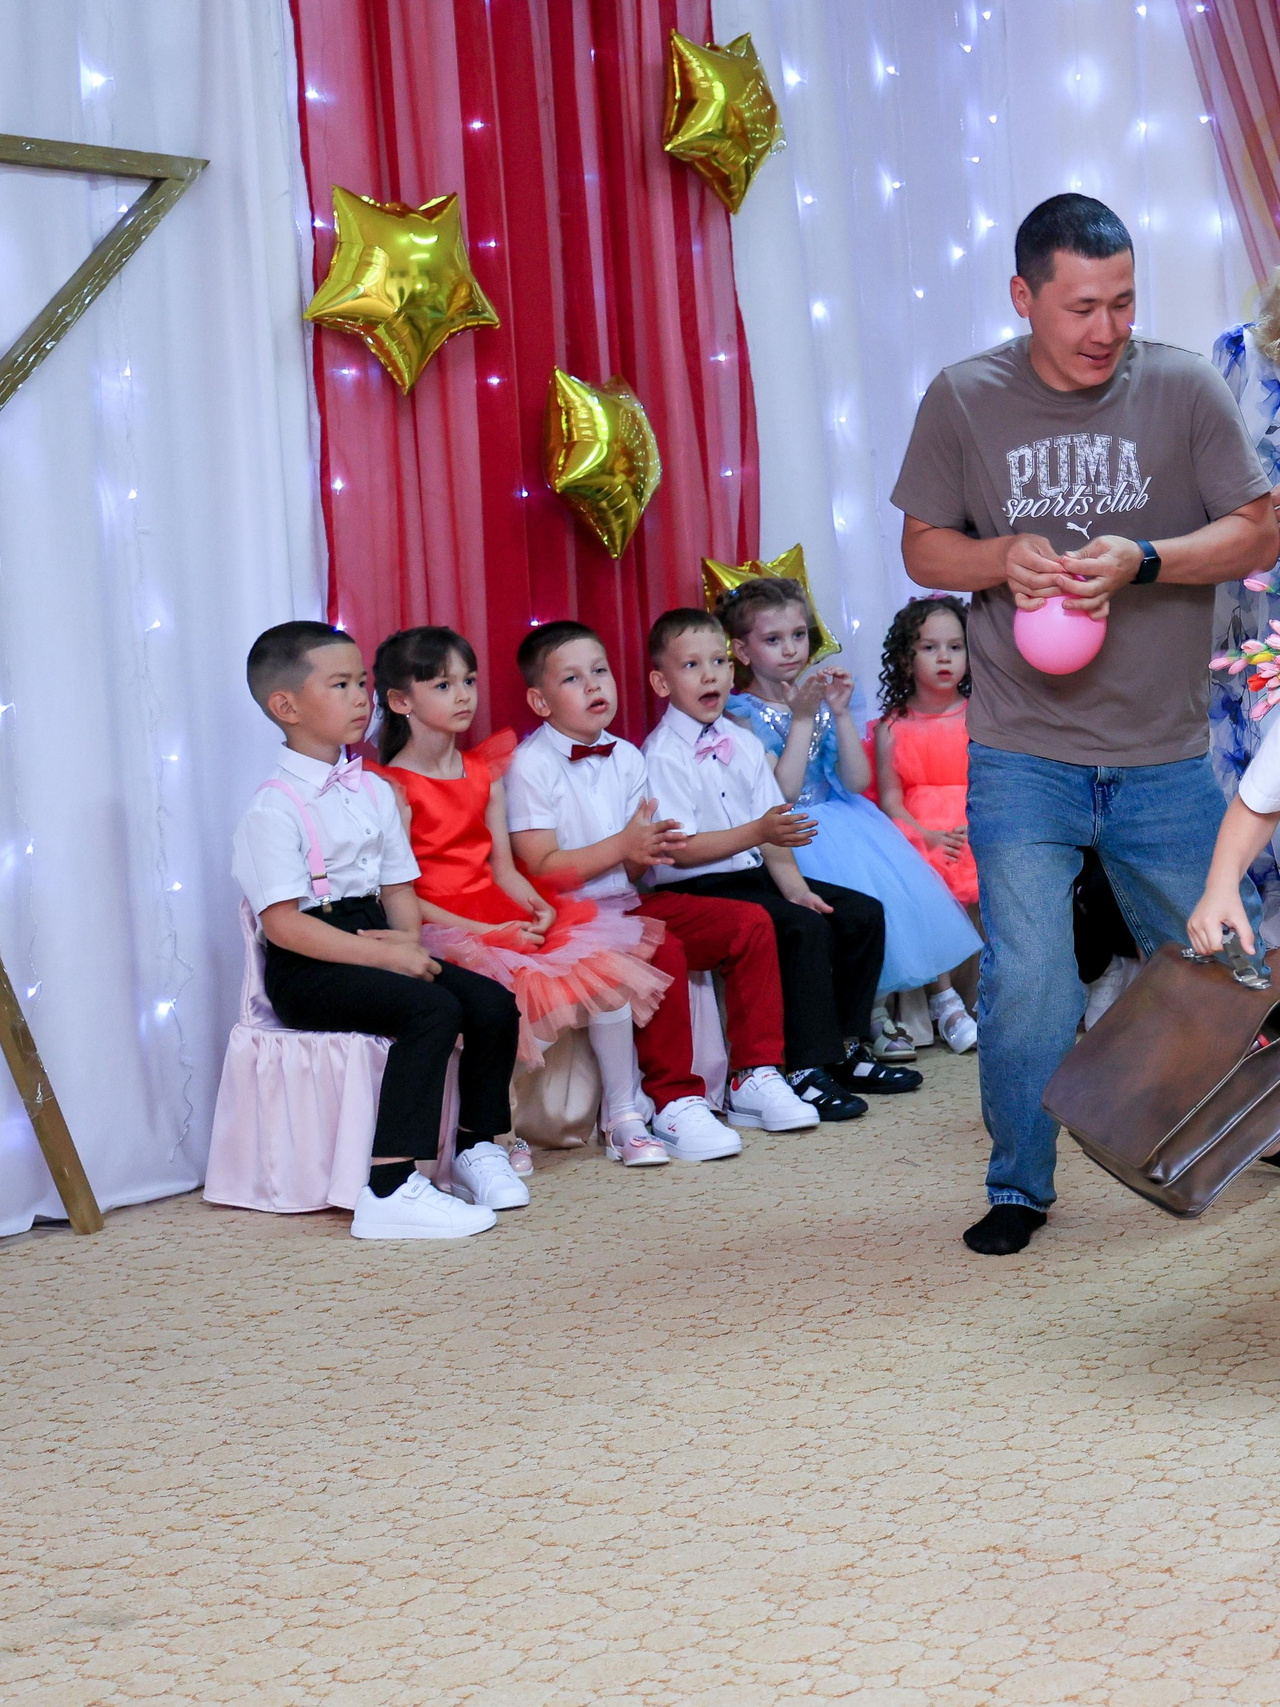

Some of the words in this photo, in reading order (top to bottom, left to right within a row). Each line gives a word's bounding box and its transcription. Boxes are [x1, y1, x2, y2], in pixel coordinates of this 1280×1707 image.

[1006, 432, 1143, 500] PUMA
[1002, 485, 1093, 526] sports
[1097, 476, 1152, 514] club
